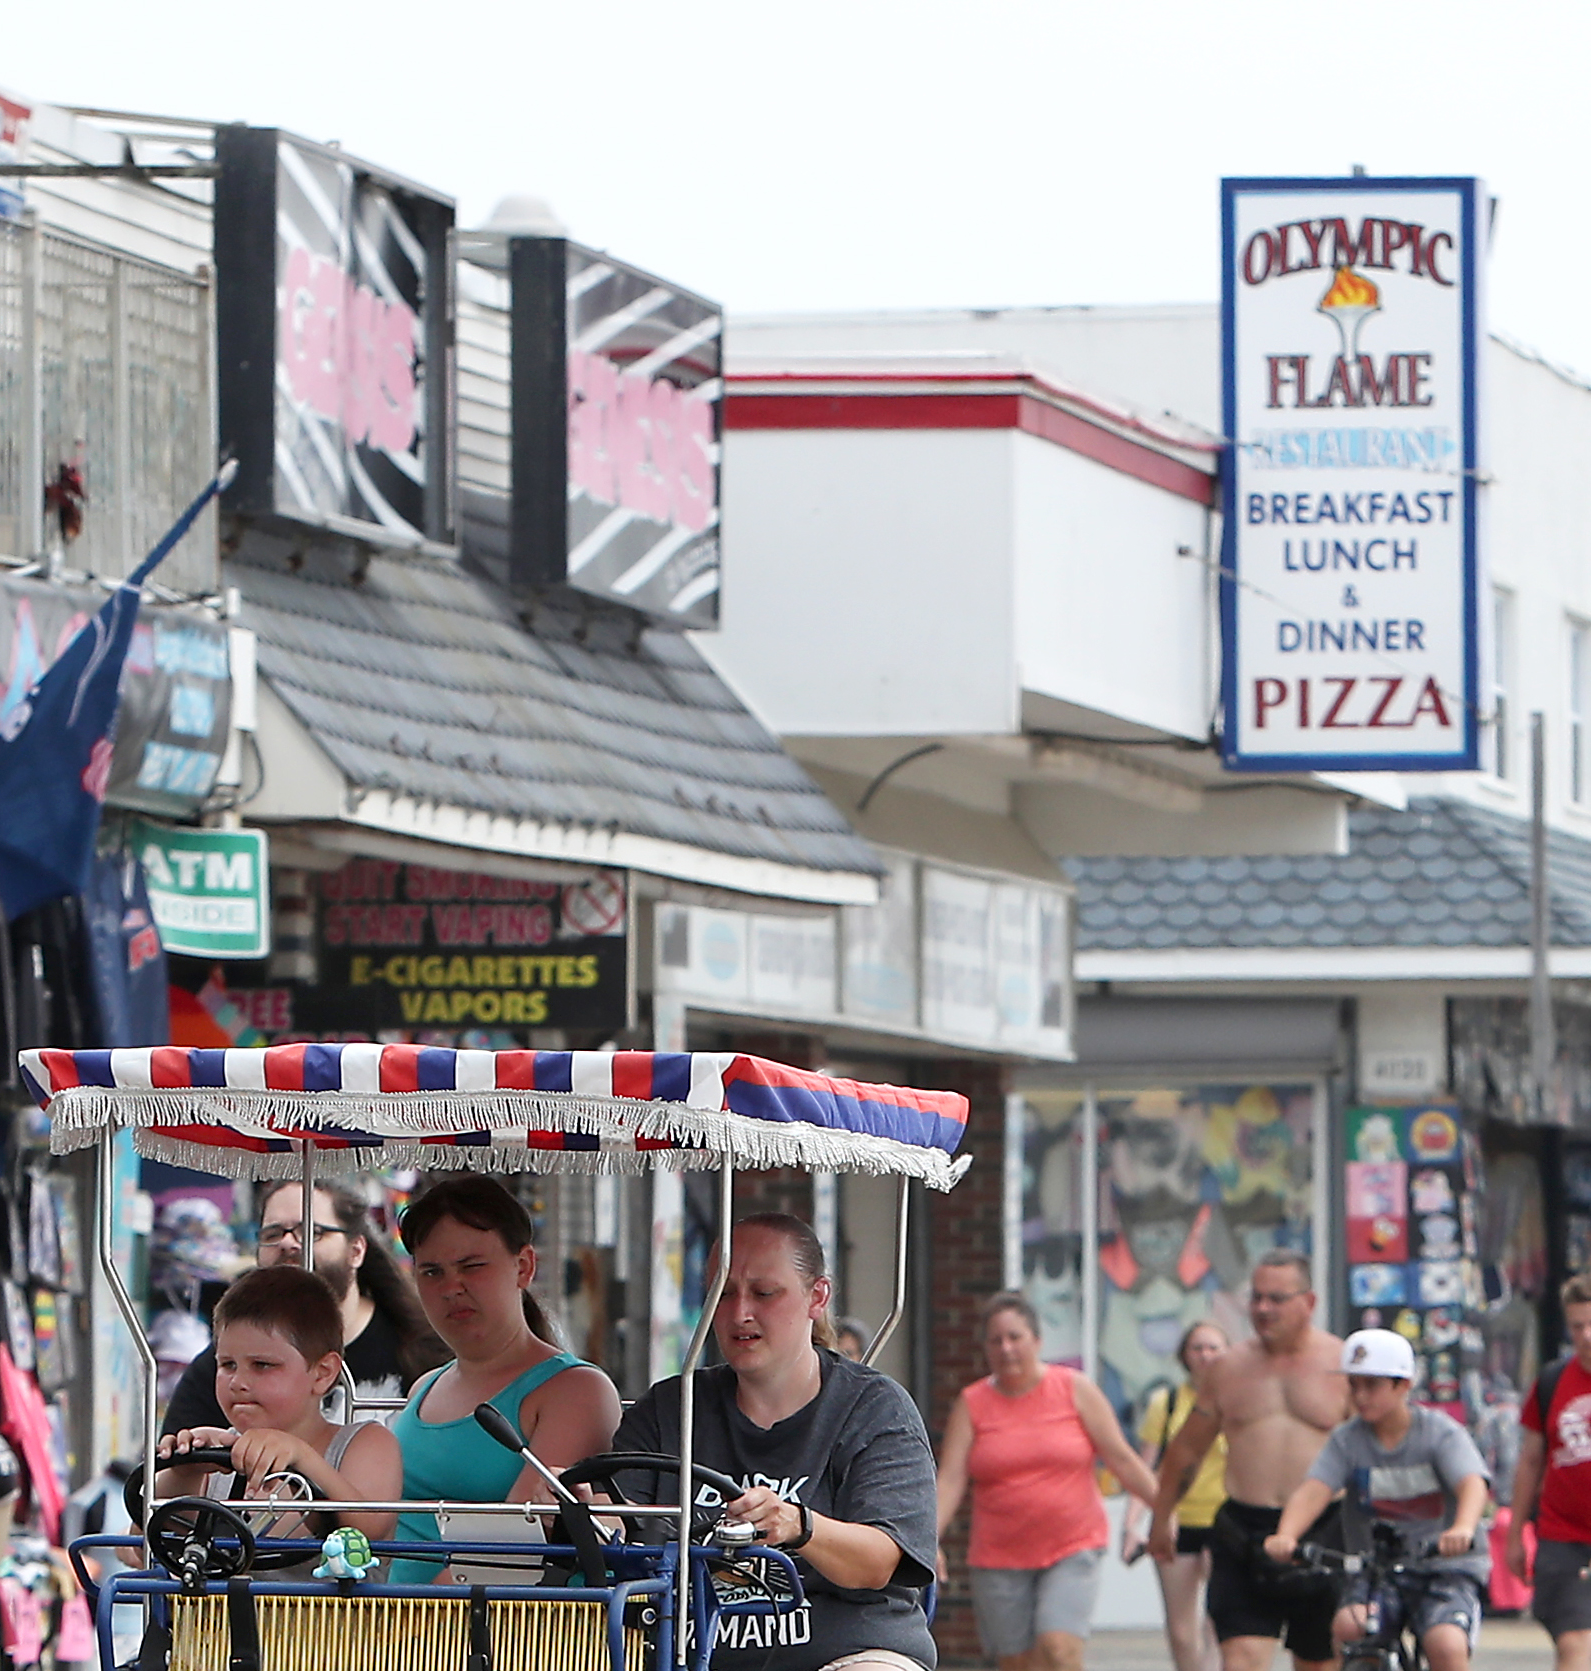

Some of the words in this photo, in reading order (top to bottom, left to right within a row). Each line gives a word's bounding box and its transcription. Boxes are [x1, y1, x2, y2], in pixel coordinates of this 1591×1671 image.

[1242, 216, 1456, 287] OLYMPIC
[1265, 353, 1434, 410] FLAME
[1250, 427, 1451, 470] RESTAURANT
[1246, 491, 1455, 526] BREAKFAST
[1283, 539, 1419, 571] LUNCH
[1341, 584, 1361, 607] &
[1278, 620, 1427, 652] DINNER
[1253, 676, 1453, 729] PIZZA
[141, 845, 254, 890] ATM
[153, 899, 247, 929] NSIDE
[325, 904, 427, 945] START
[432, 903, 552, 945] VAPING
[350, 954, 600, 988] E-CIGARETTES
[399, 990, 549, 1024] VAPORS
